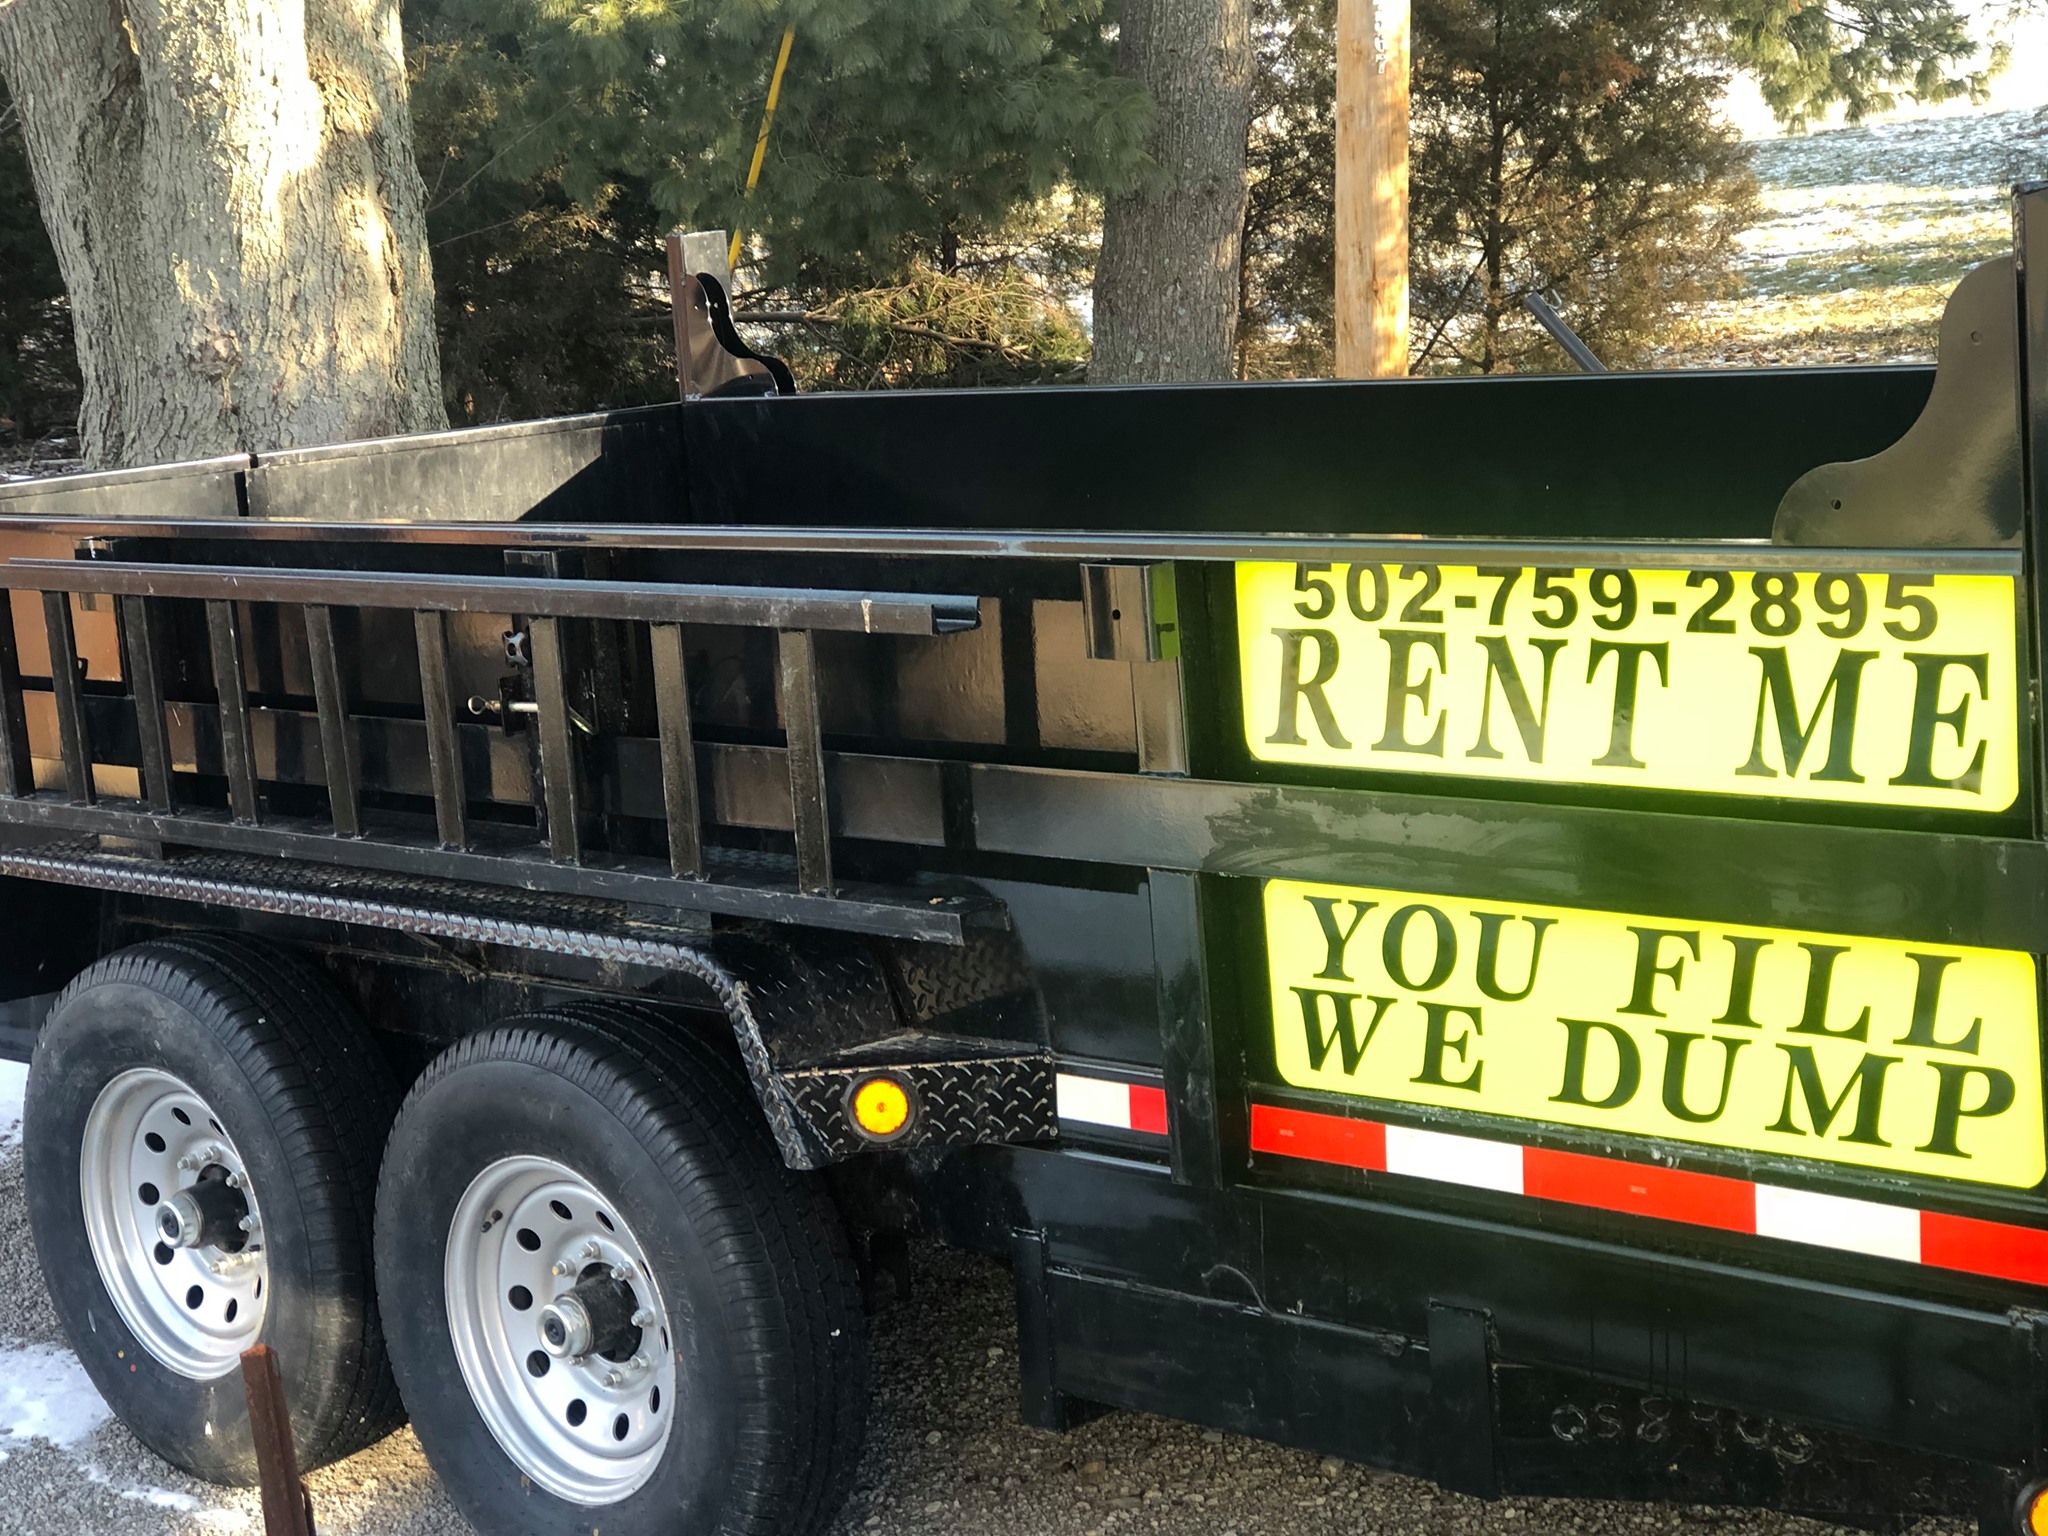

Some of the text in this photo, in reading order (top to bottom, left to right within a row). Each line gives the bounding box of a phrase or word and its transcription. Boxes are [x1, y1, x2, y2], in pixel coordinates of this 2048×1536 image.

[1293, 562, 1939, 641] 502-759-2895
[1265, 628, 1990, 795] RENT ME
[1303, 894, 1983, 1056] YOU FILL
[1288, 985, 2016, 1160] WE DUMP
